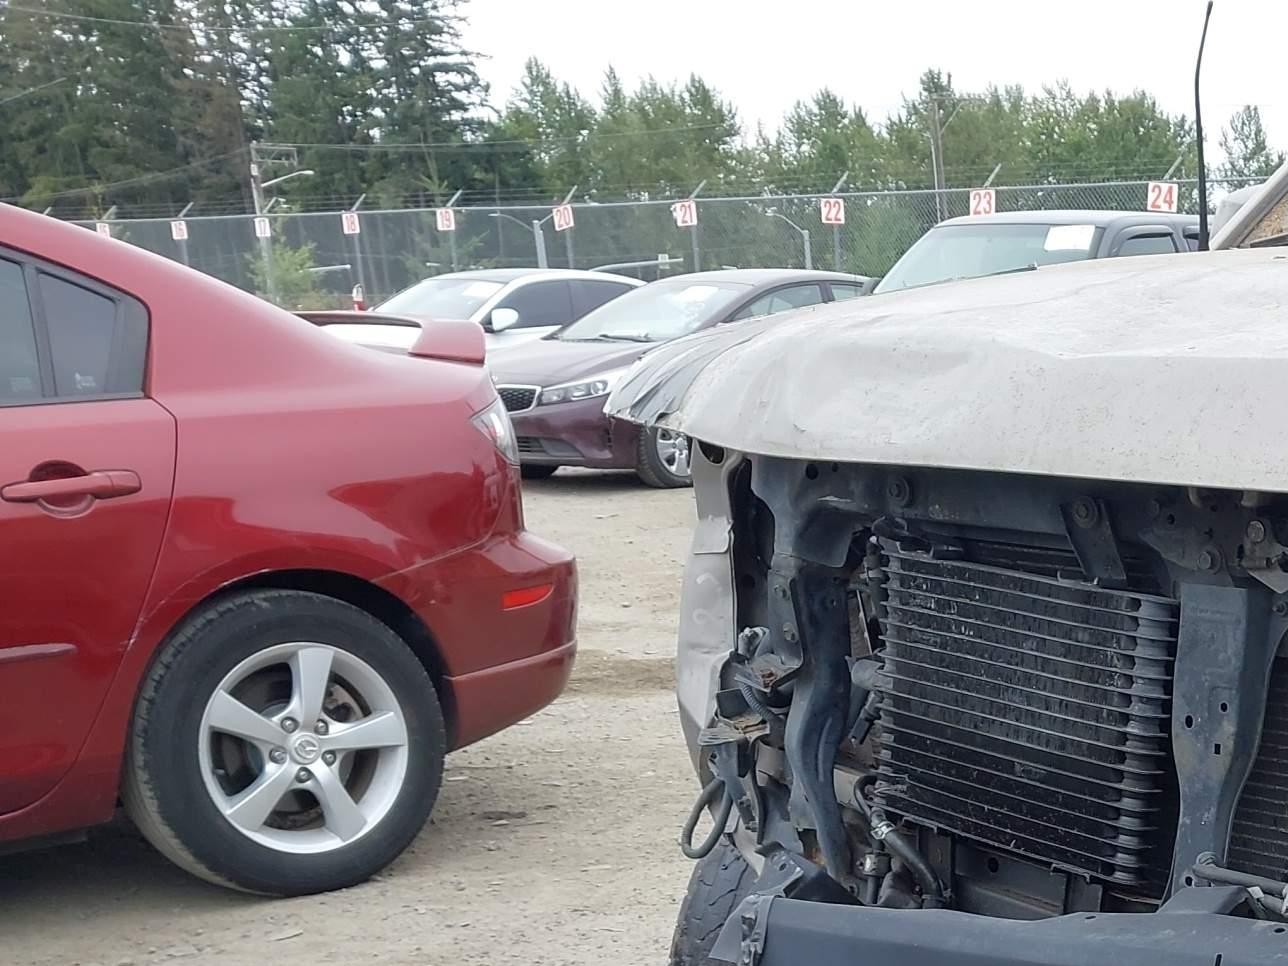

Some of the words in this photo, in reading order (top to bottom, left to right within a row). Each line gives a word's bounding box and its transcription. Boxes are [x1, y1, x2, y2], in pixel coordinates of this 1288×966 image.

[973, 191, 992, 215] 23
[1151, 184, 1174, 210] 24
[440, 210, 451, 228] 19
[556, 207, 570, 228] 20
[680, 204, 693, 224] 21
[824, 200, 842, 221] 22
[345, 214, 356, 231] 18
